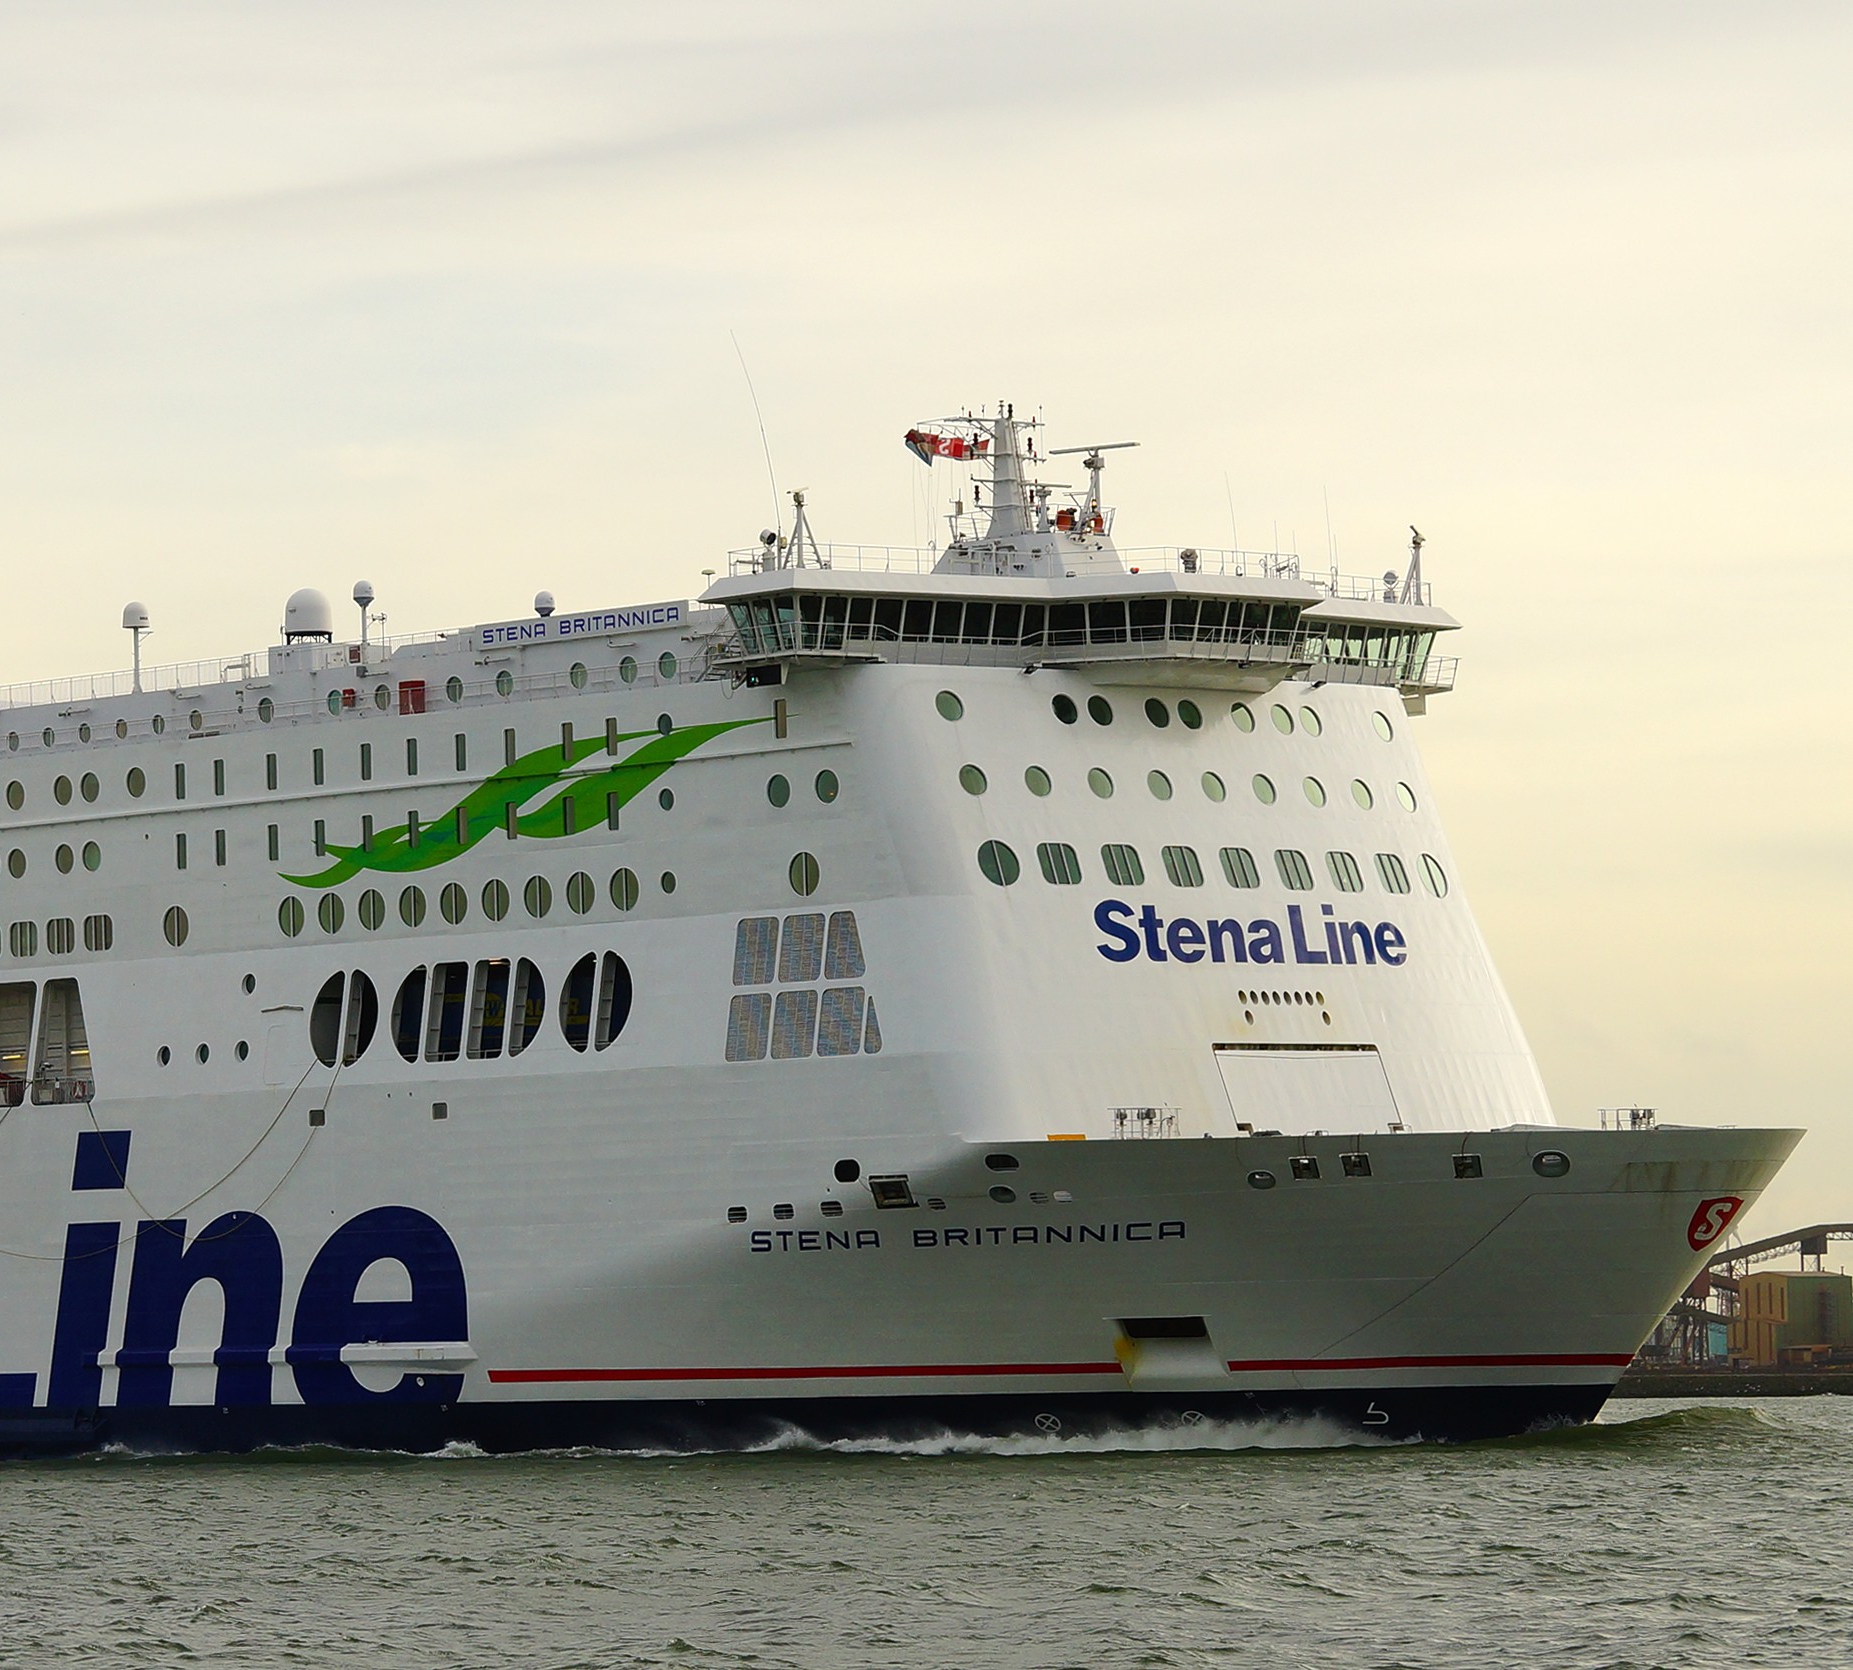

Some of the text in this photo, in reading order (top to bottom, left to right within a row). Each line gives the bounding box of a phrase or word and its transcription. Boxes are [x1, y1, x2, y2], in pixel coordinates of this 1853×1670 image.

[482, 607, 679, 644] STENA BRITANNICA
[1094, 899, 1408, 966] Stena Line
[750, 1220, 1186, 1252] STENA BRITANNICA
[1694, 1203, 1732, 1240] S
